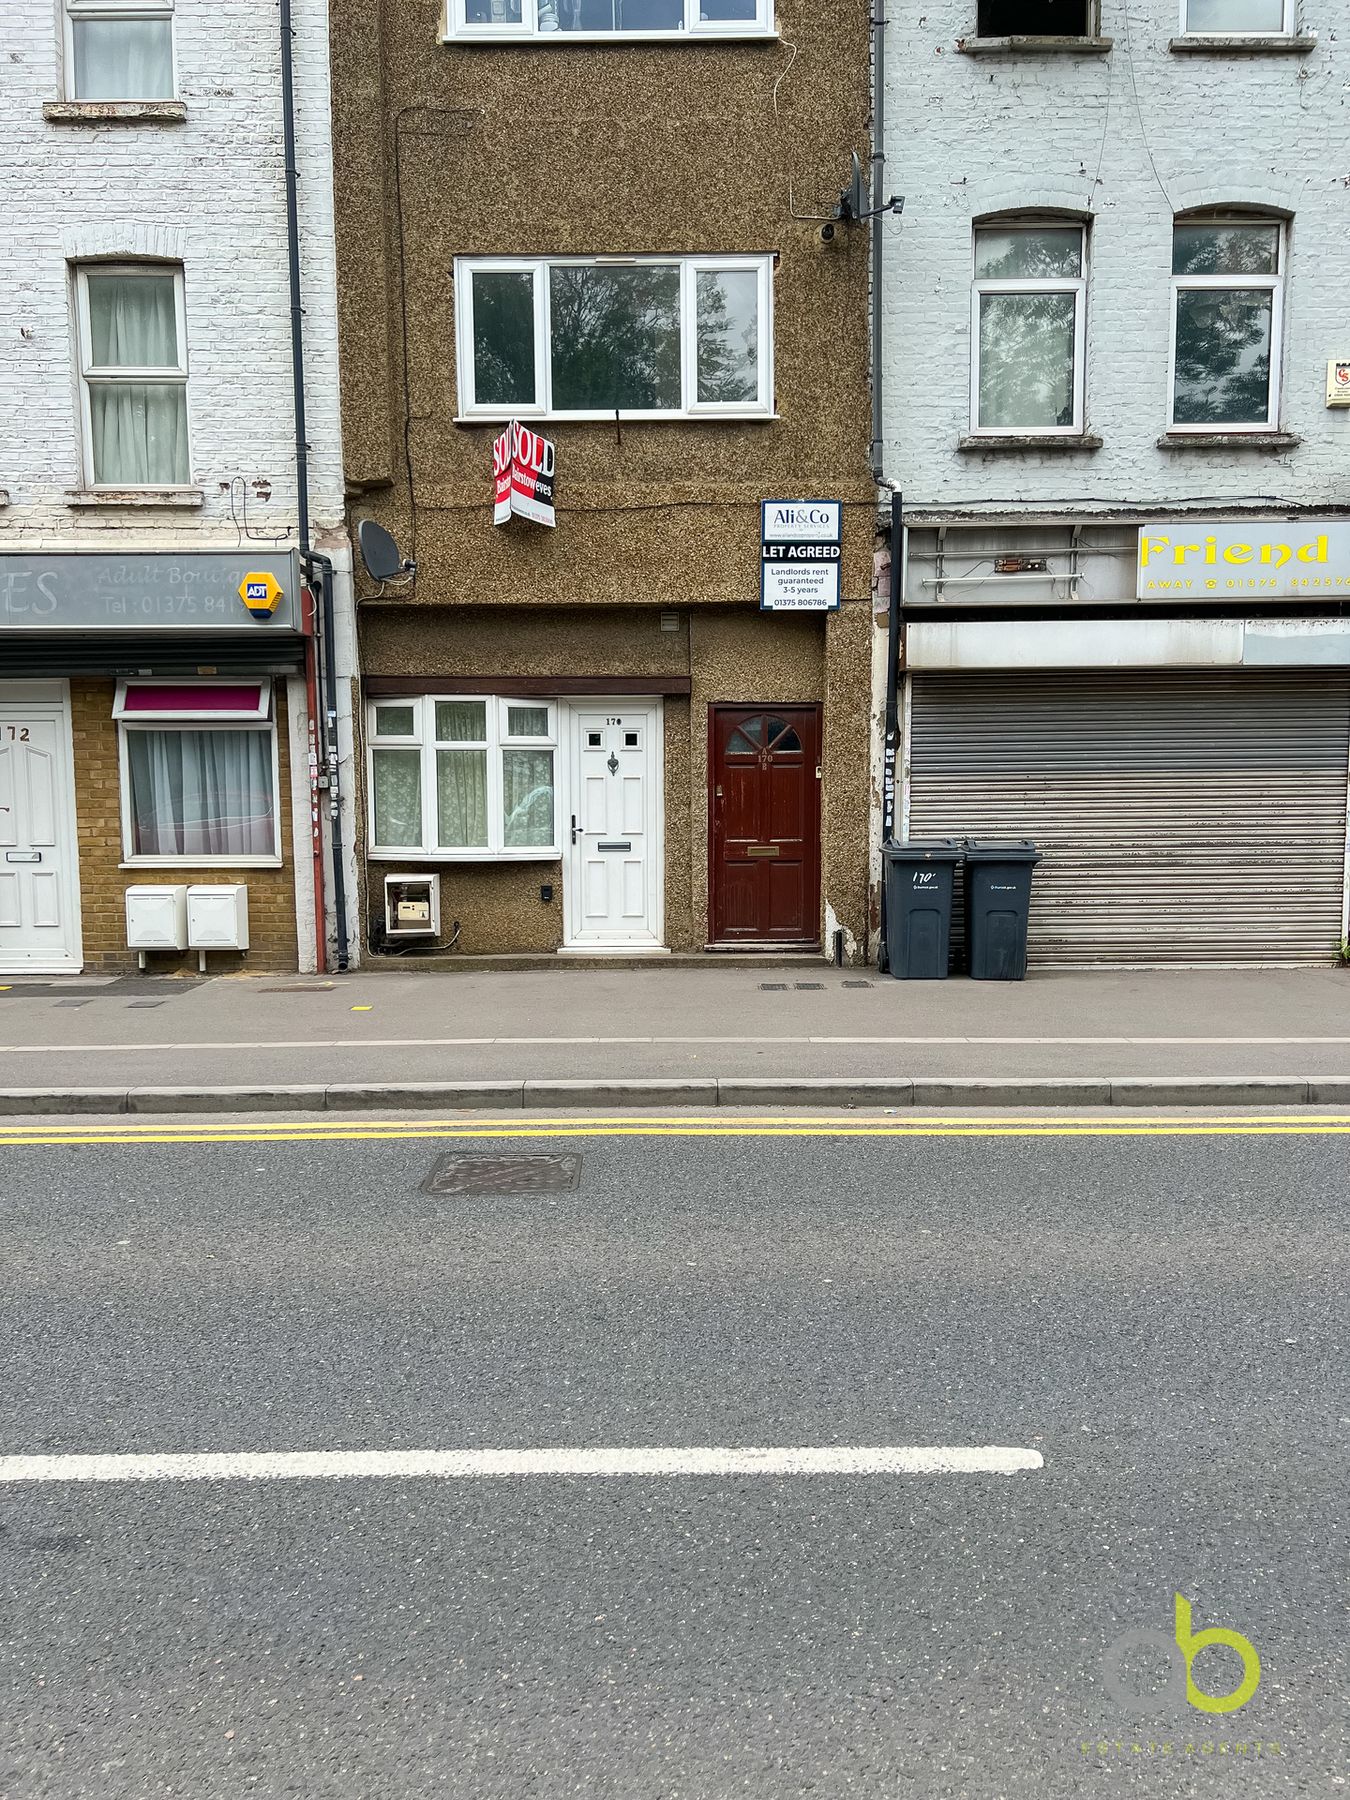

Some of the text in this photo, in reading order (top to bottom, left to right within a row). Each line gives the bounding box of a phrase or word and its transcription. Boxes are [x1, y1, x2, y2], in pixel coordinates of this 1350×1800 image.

[512, 420, 555, 478] SOLD
[773, 509, 830, 524] Ali&Co
[762, 546, 841, 558] LET AGREED
[1141, 535, 1328, 569] Friend
[96, 565, 164, 584] Adult
[771, 568, 811, 576] Landlords
[777, 577, 824, 586] guaranteed
[1147, 579, 1193, 589] AWAY
[1226, 579, 1277, 588] 01375
[247, 585, 267, 597] ADT
[783, 586, 819, 595] 3-5 years
[141, 596, 197, 614] 01375
[758, 754, 773, 763] 170
